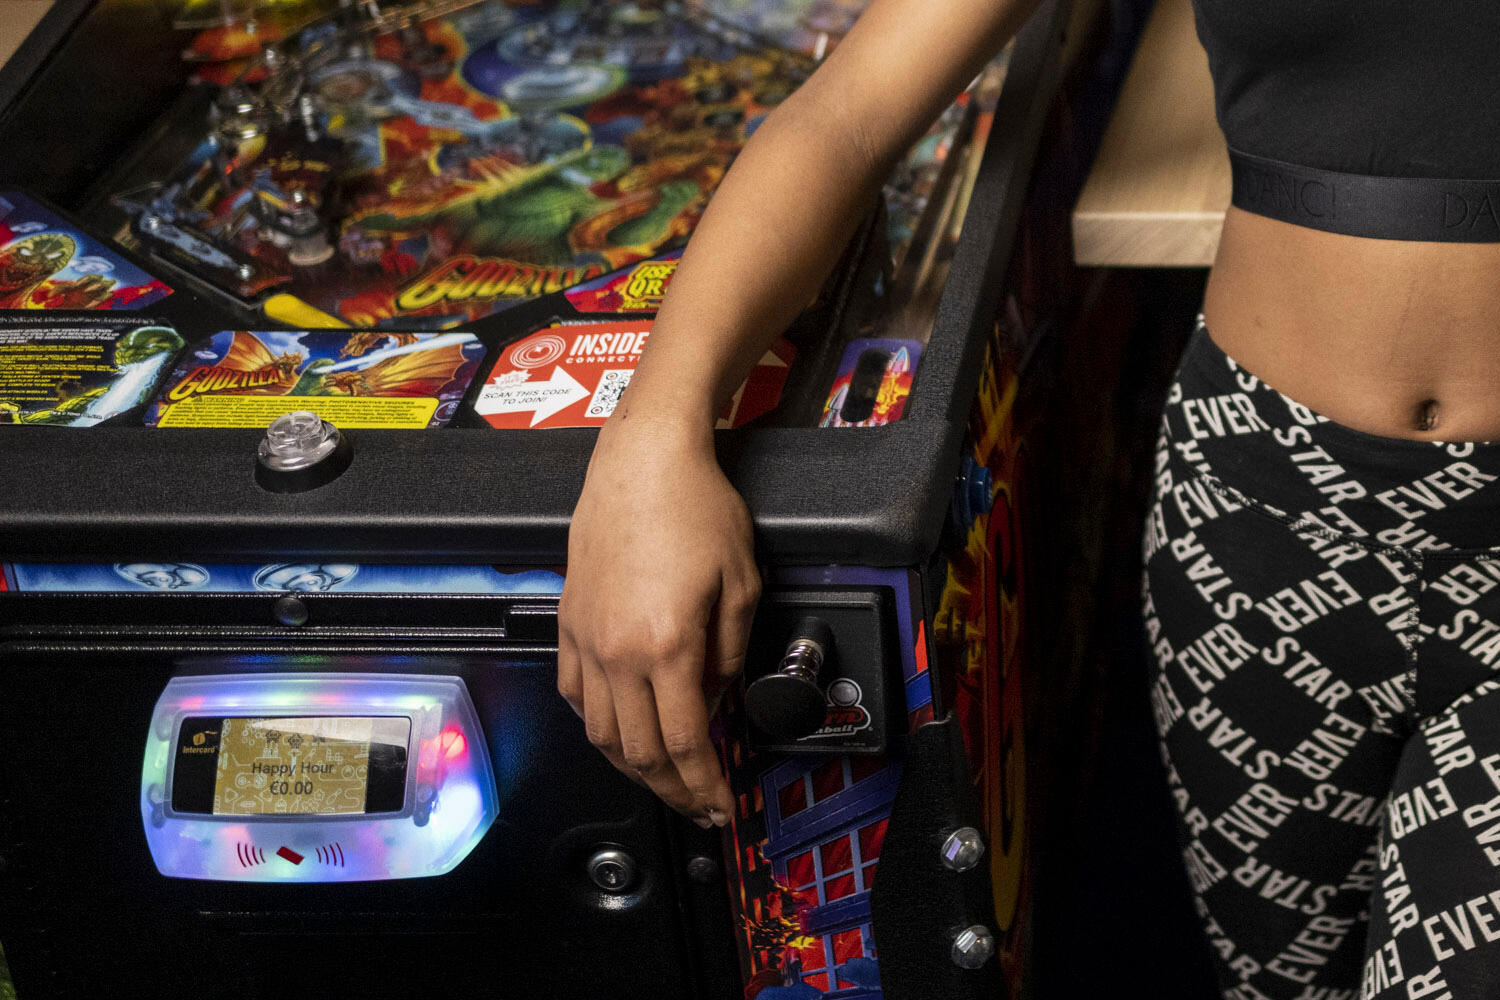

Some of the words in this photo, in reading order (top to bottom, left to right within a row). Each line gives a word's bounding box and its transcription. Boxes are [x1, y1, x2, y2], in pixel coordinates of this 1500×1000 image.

[628, 279, 663, 298] QR
[565, 355, 641, 364] CONNECT
[569, 332, 650, 356] INSIDE
[169, 366, 279, 400] GODZILLA
[483, 391, 513, 399] SCAN
[1183, 393, 1271, 439] EVER
[1273, 425, 1368, 504] STAR
[1376, 461, 1498, 520] EVER
[1170, 531, 1252, 621] STAR
[1254, 570, 1362, 632] EVER
[1176, 622, 1259, 693] EVER
[1262, 637, 1353, 710] STAR
[1187, 697, 1281, 779] STAR
[1282, 712, 1366, 780] EVER
[252, 762, 297, 777] Happy
[301, 762, 336, 774] Hour
[270, 781, 313, 795] €0.00
[1211, 783, 1299, 852] EVER
[1389, 777, 1458, 839] EVER
[1232, 856, 1338, 914] STAR
[1380, 843, 1419, 937] STAR
[1265, 915, 1355, 983] EVER
